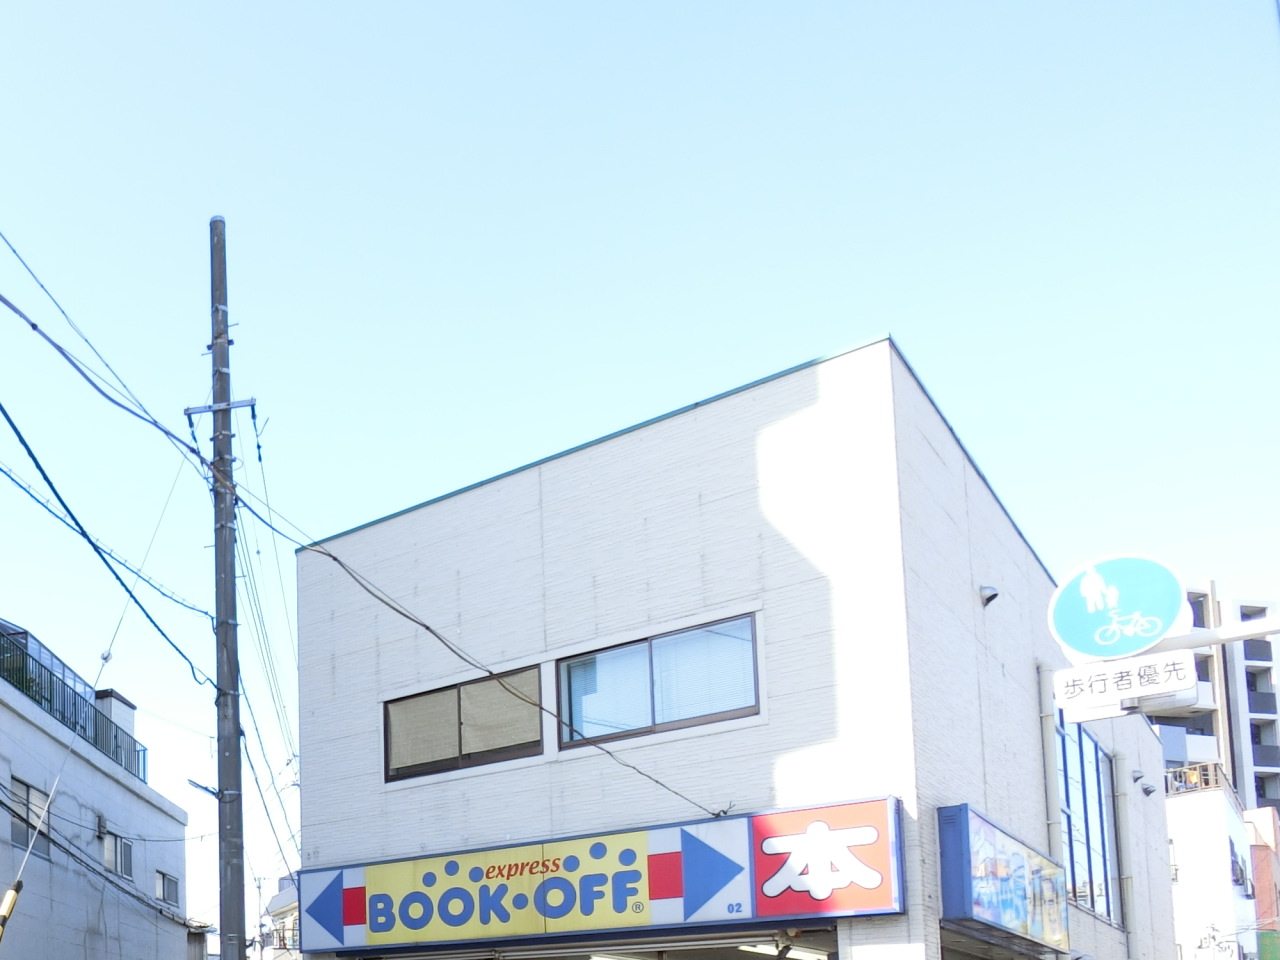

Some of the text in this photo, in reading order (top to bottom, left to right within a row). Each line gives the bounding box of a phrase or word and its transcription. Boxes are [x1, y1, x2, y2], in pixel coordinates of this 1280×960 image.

[1064, 661, 1186, 700] 歩行者優先
[484, 856, 561, 883] express
[760, 820, 884, 902] 本
[726, 902, 743, 915] 02
